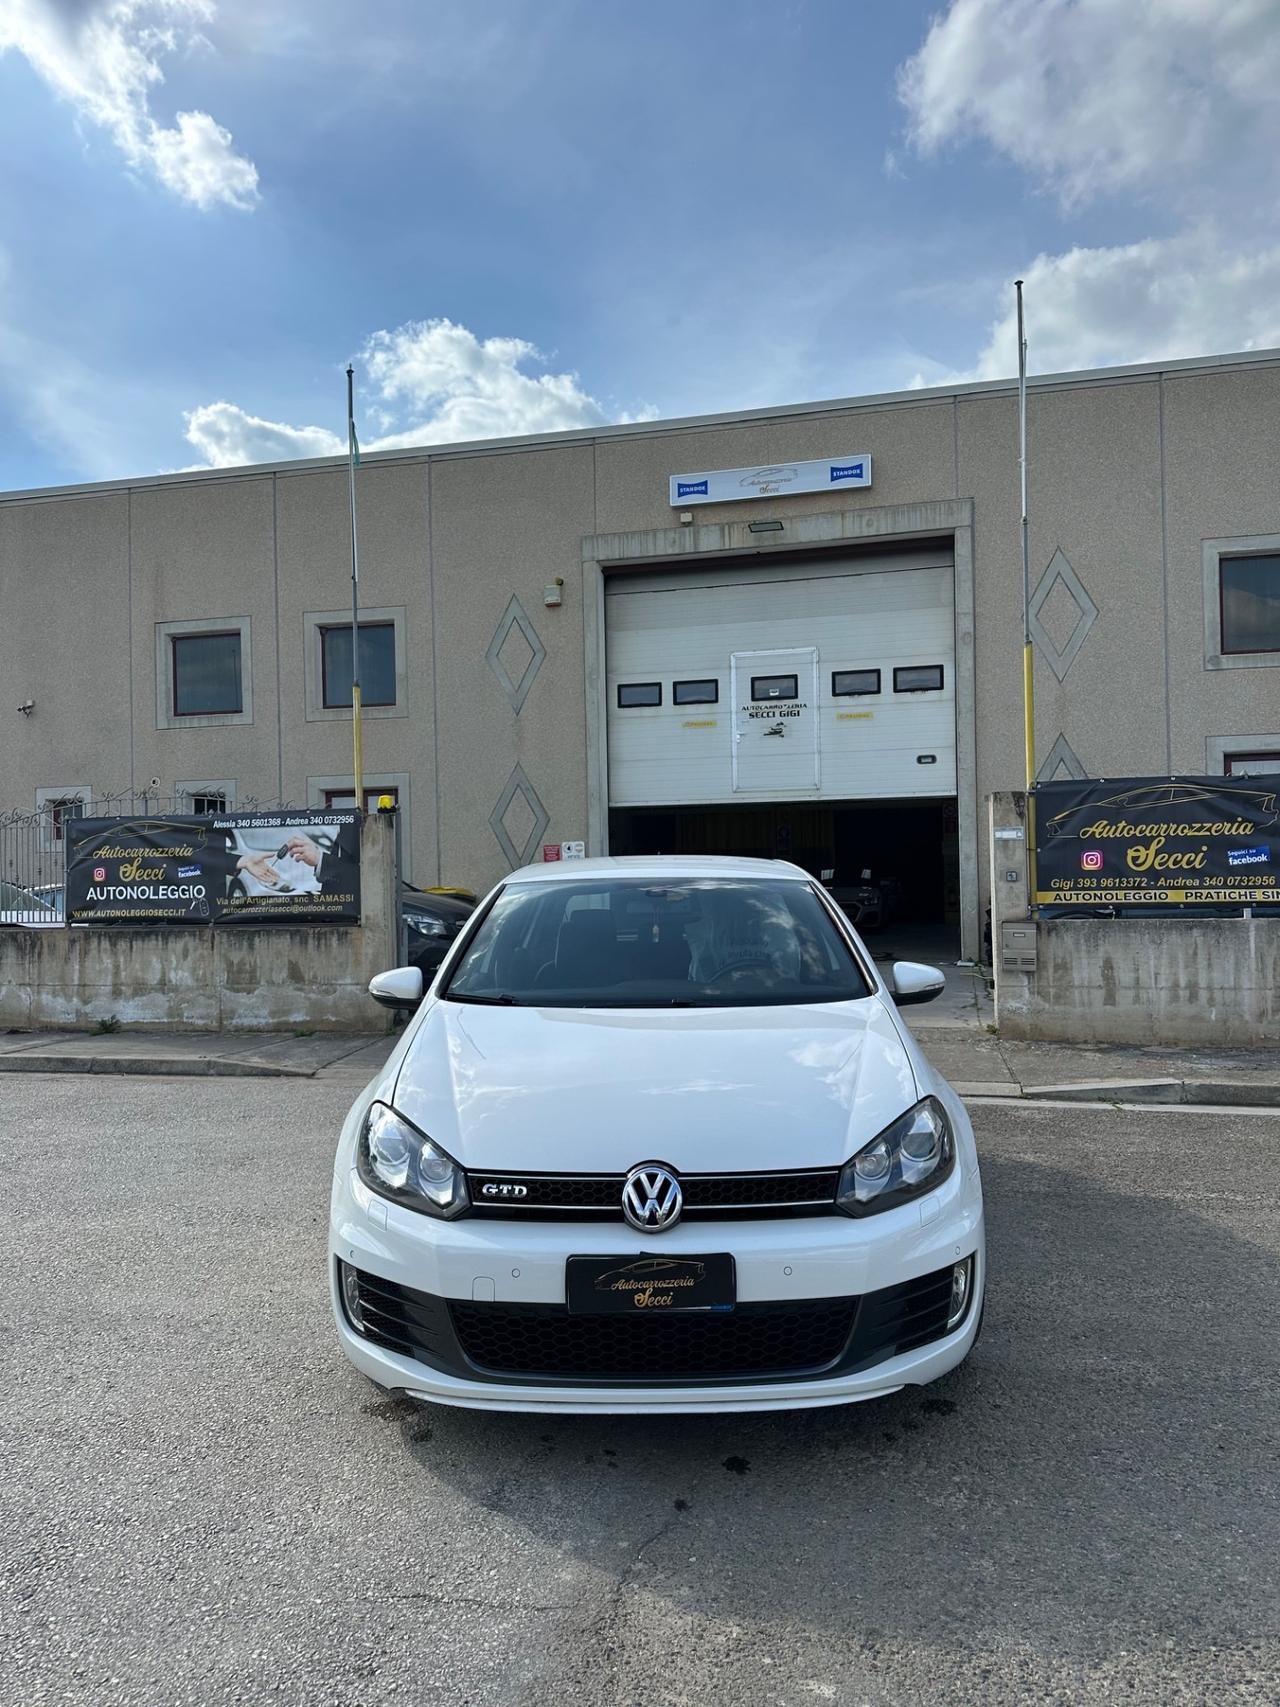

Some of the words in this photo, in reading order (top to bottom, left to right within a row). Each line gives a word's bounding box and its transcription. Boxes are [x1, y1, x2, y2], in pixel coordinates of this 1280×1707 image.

[779, 710, 800, 718] GIGI
[213, 820, 236, 828] Alessia
[236, 819, 250, 827] 340
[251, 818, 281, 827] 5601368
[285, 817, 308, 826] Andrea
[309, 816, 322, 825] 340
[324, 815, 354, 824] 0732956
[1080, 817, 1256, 839] Autocarrozzeria
[92, 843, 193, 859] Autocarrozzeria
[1126, 837, 1208, 871] Secci
[1229, 853, 1268, 865] facebook
[119, 858, 167, 882] Secci
[1050, 878, 1074, 890] Gigi
[1077, 878, 1097, 888] 393
[1100, 877, 1148, 888] 9613372
[1157, 876, 1200, 887] Andrea
[1203, 876, 1224, 886] 340
[1226, 875, 1276, 886] 0732956
[86, 885, 205, 900] AUTONOLEGGIO
[313, 894, 354, 902] SAMASSI
[1053, 891, 1169, 902] AUTONOLEGGIO
[1184, 890, 1258, 901] PRATICHE
[72, 909, 186, 918] WWW.AUTONOLEGGIOSECCI.IT
[482, 1183, 528, 1197] GTD
[611, 1275, 695, 1291] Autocarrozzeria
[634, 1287, 673, 1307] Secci
